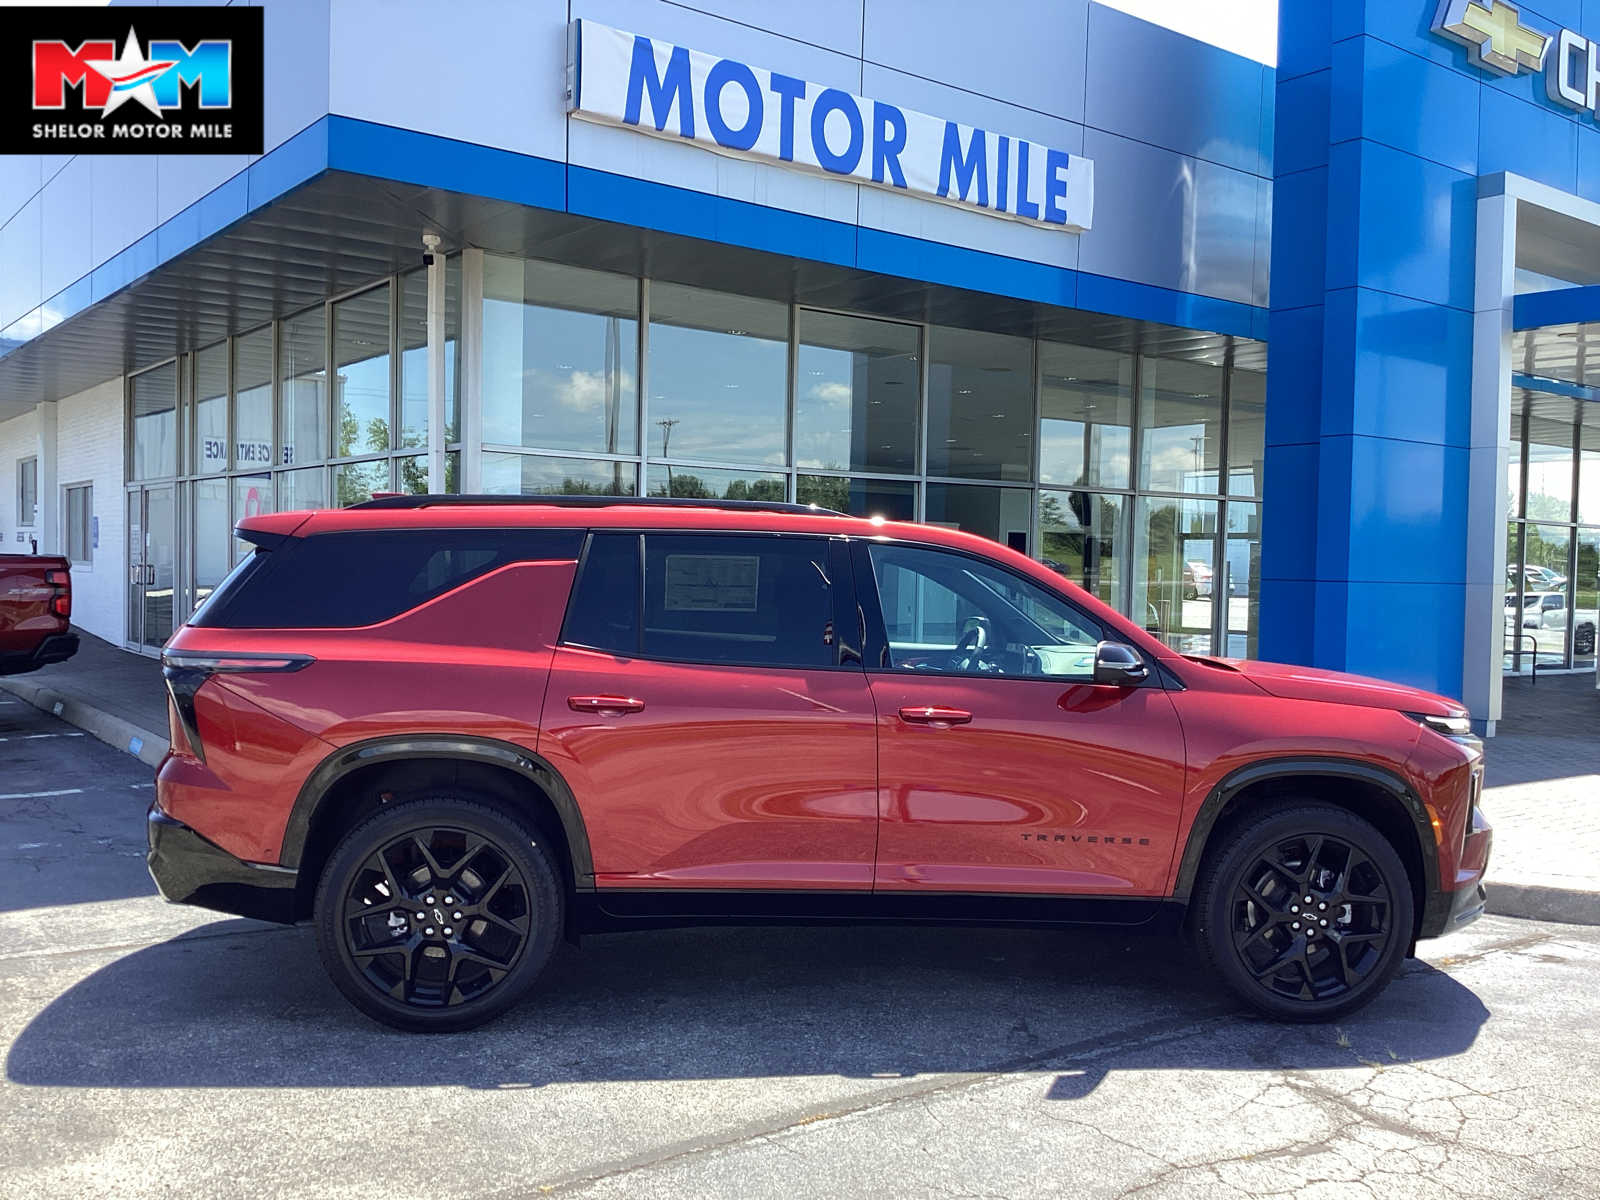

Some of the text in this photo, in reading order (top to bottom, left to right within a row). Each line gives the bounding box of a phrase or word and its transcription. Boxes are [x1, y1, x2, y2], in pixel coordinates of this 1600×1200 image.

[622, 35, 1070, 226] MOTOR MILE
[1020, 833, 1150, 846] TRAVERSE
